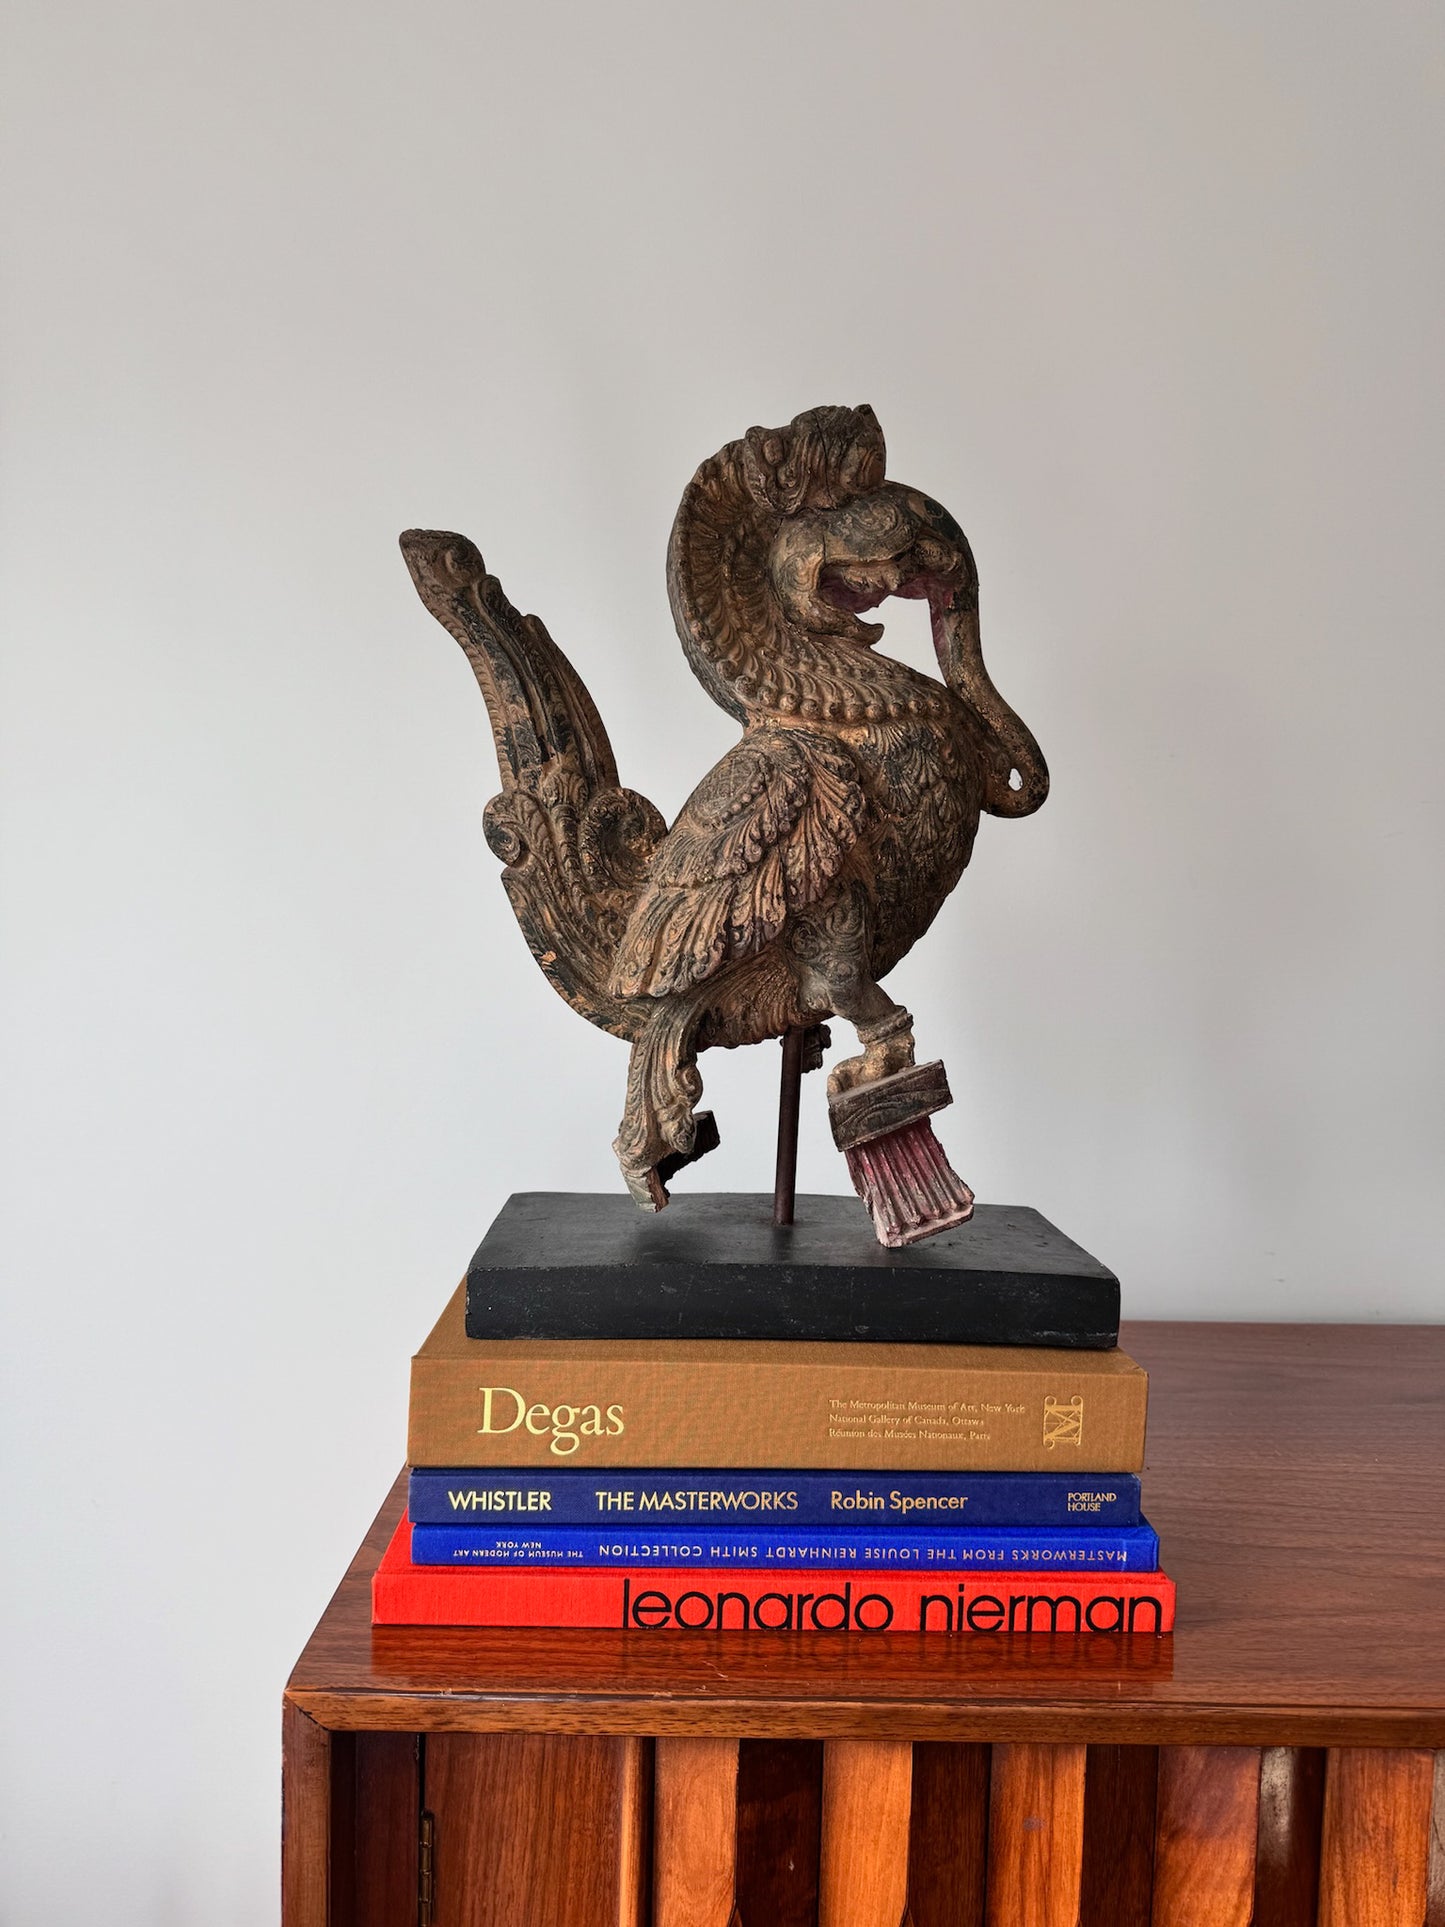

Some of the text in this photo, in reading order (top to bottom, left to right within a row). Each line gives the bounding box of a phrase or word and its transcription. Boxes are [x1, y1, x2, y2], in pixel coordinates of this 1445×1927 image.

[829, 1399, 847, 1409] The
[850, 1400, 905, 1411] Metropolitan
[908, 1402, 946, 1411] Museum
[947, 1402, 959, 1411] of
[980, 1403, 1002, 1413] New
[1004, 1404, 1025, 1413] York
[477, 1387, 625, 1455] Degas
[829, 1414, 866, 1423] National
[869, 1415, 901, 1425] Gallery
[902, 1415, 913, 1424] of
[952, 1417, 985, 1426] Ottawa
[867, 1429, 882, 1438] des
[969, 1431, 991, 1440] Paris
[448, 1490, 968, 1514] WHISTLER THE MASTERWORKS Robin Spencer
[1067, 1492, 1117, 1502] PORTLAND
[1067, 1502, 1101, 1511] HOUSE
[496, 1541, 542, 1549] NEW YORK
[453, 1549, 470, 1557] ART
[472, 1549, 510, 1558] MODERN
[528, 1550, 563, 1558] MUSEUM
[567, 1550, 584, 1558] THE
[599, 1545, 1127, 1562] MASTERWORKS FROM THE LOUISE REINHARDT SMITH COLLECTION
[622, 1578, 1162, 1633] leonardo nierman
